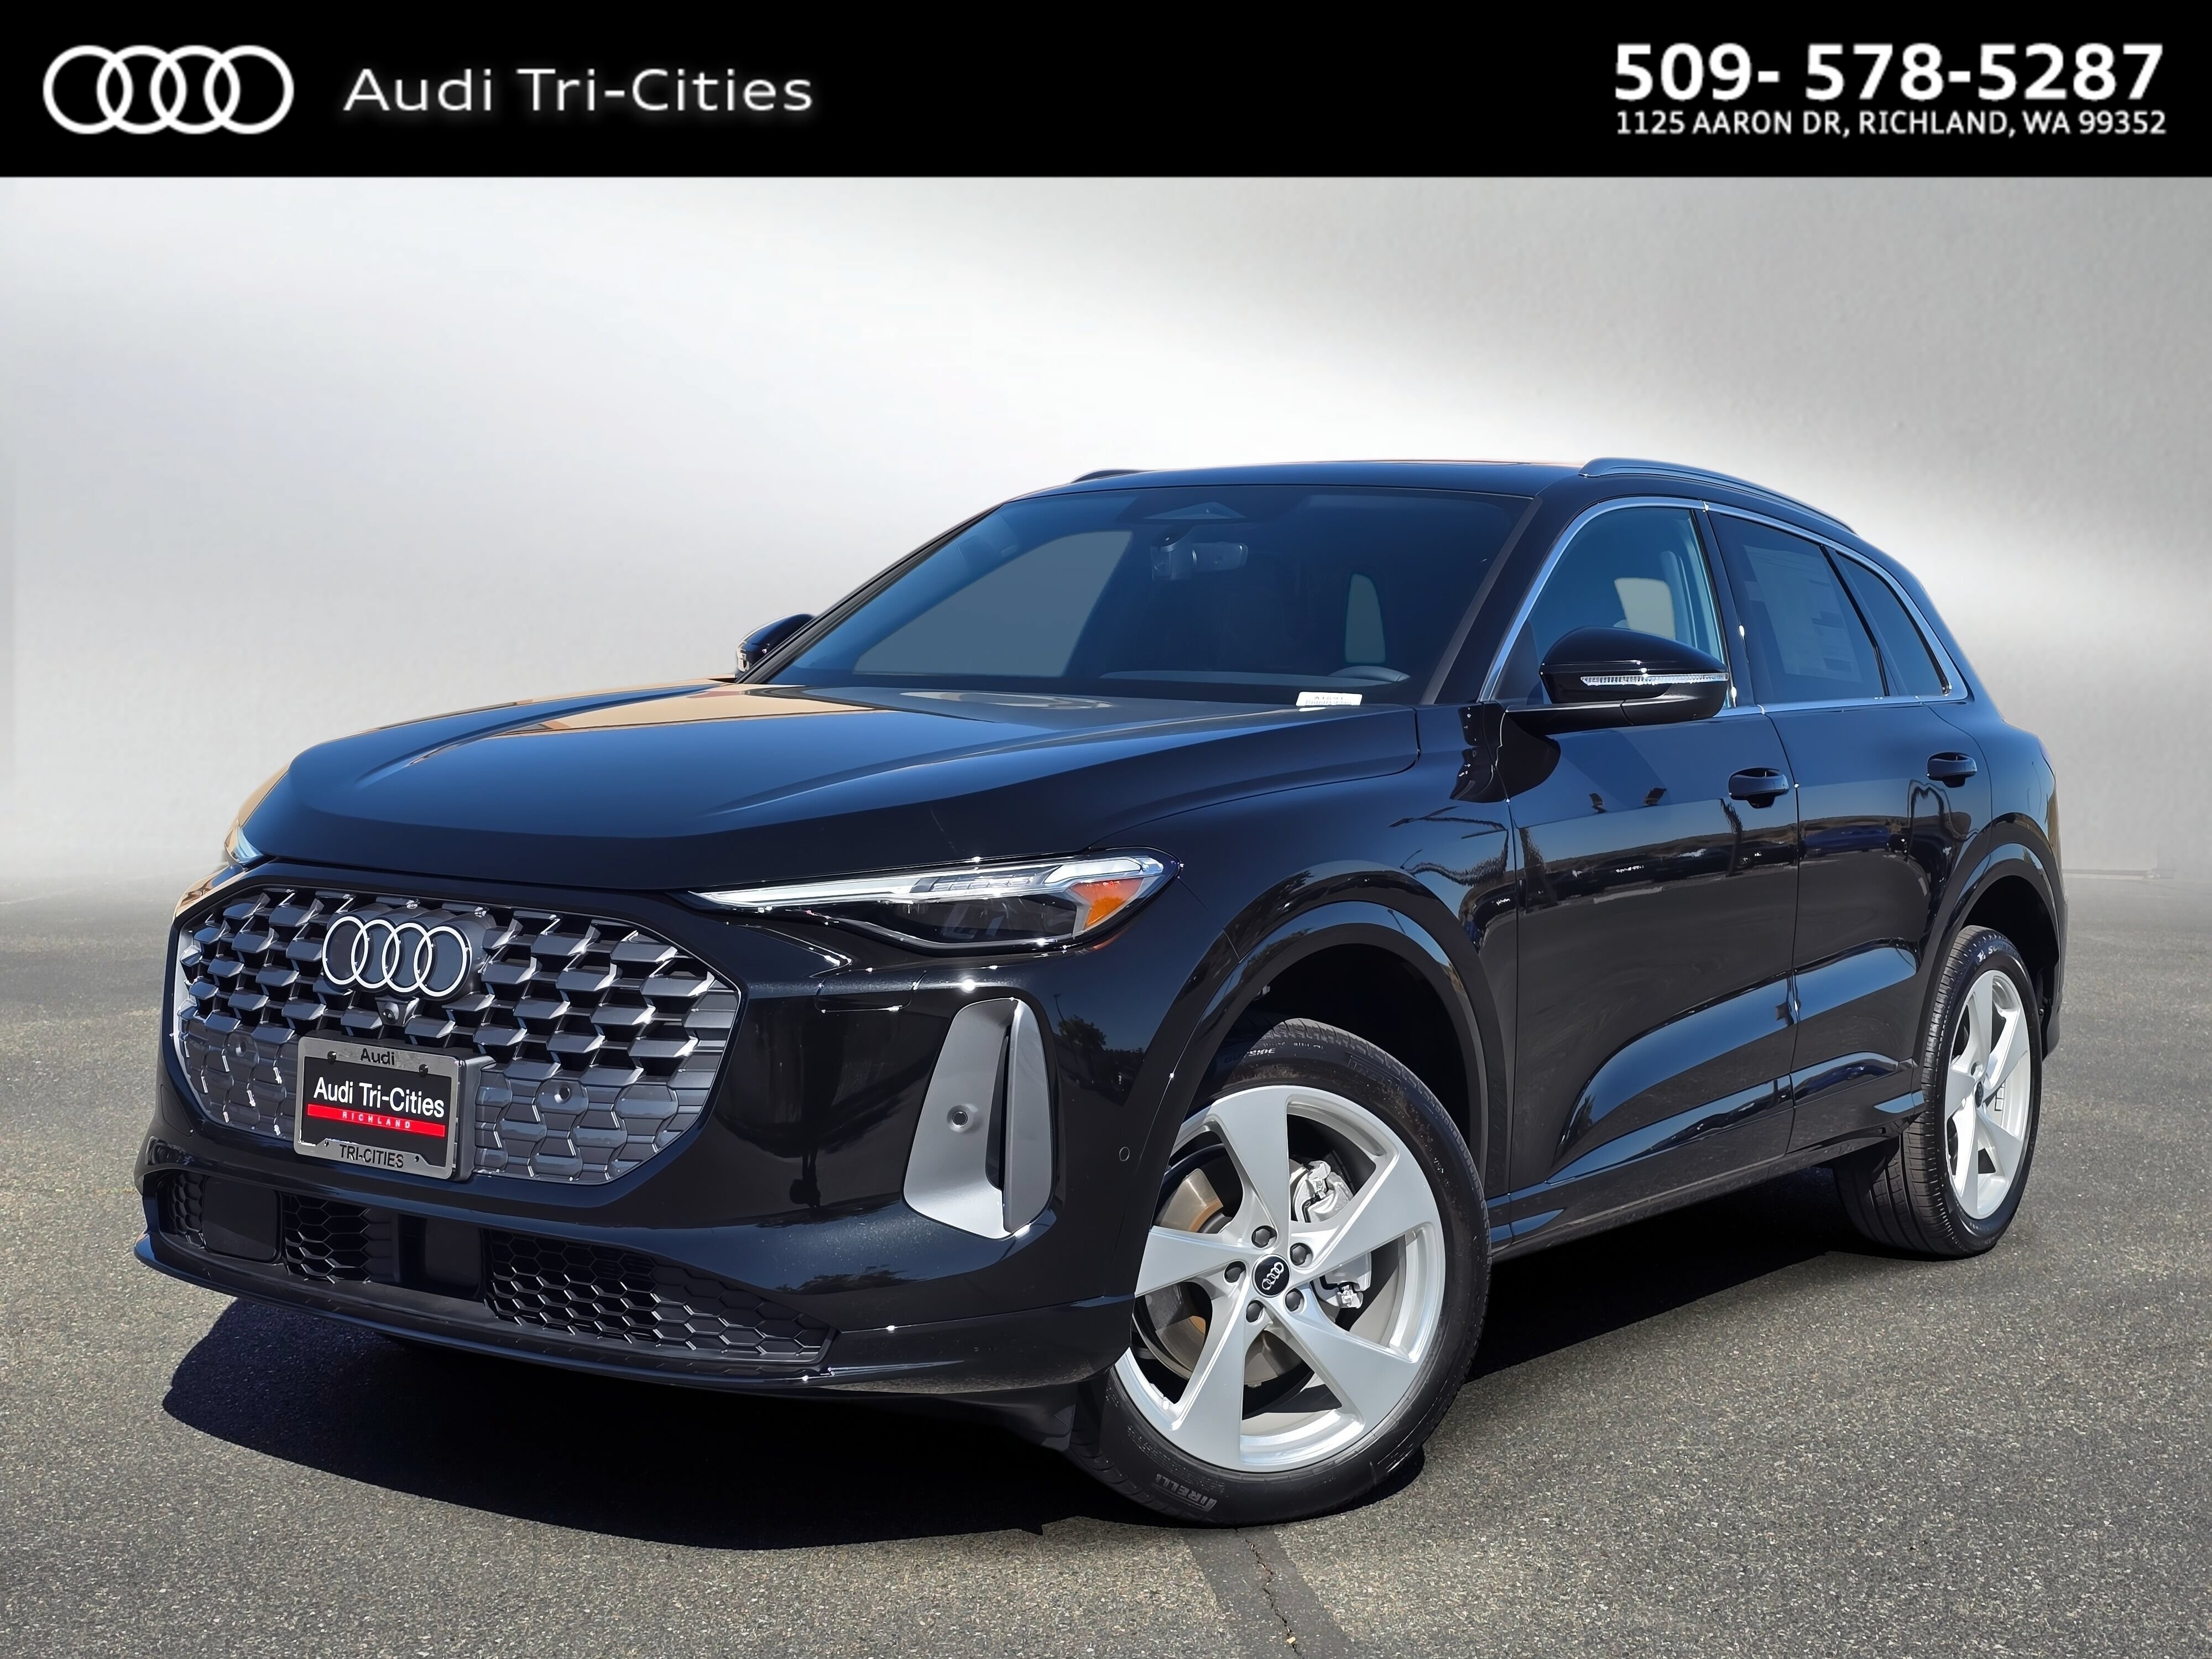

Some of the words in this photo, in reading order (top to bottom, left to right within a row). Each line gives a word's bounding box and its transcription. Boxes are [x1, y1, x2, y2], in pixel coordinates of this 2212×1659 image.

[361, 1047, 395, 1066] Audi
[313, 1077, 353, 1104] Audi
[359, 1082, 445, 1118] Tri-Cities
[342, 1110, 410, 1129] RICHLAND
[339, 1144, 404, 1168] TRI-CITIES
[1149, 1473, 1217, 1512] PIRELLI
